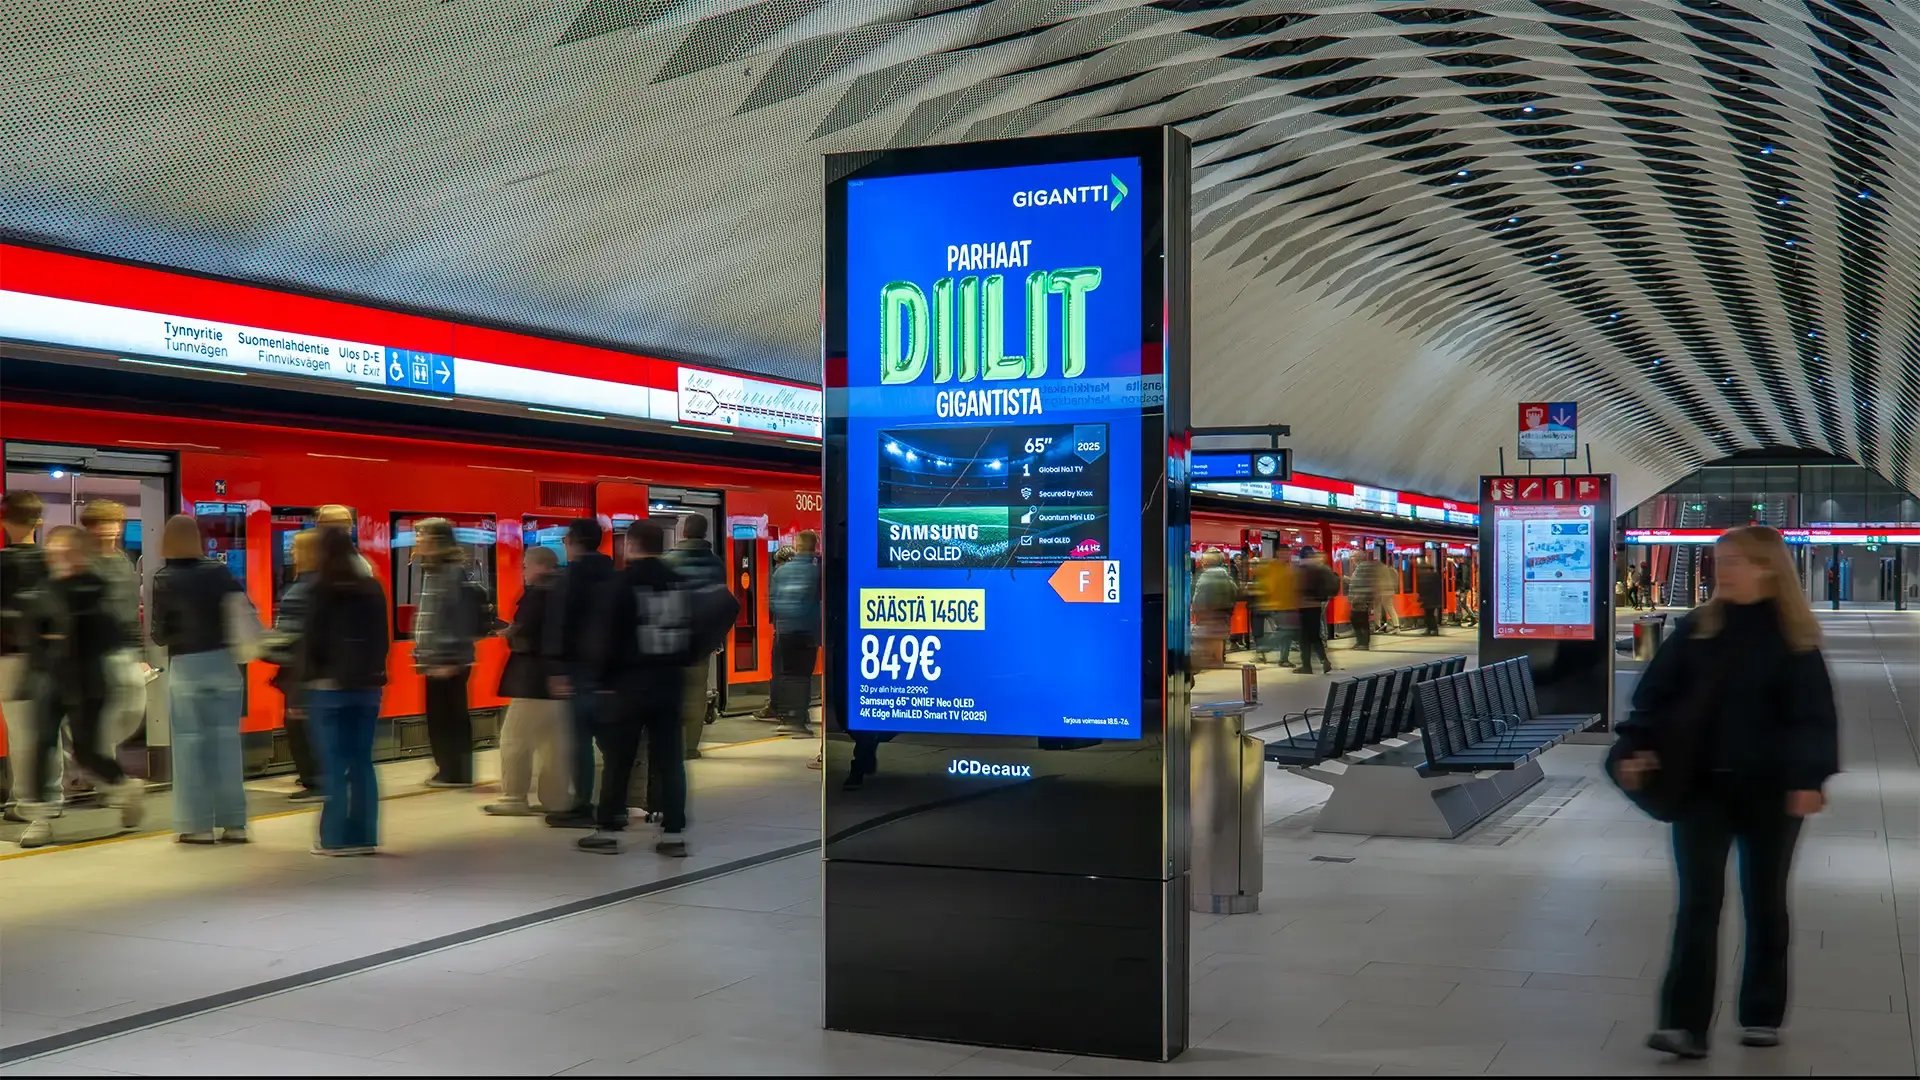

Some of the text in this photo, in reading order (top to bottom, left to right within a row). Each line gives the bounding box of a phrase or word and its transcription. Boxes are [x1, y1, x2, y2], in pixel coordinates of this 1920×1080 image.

[1012, 184, 1108, 208] GIGANTTI
[947, 239, 1032, 271] PARHAAT
[880, 266, 1102, 385] DIILIT
[164, 321, 380, 363] Tynnyritie Suomenlahdentie Ulos D-E
[165, 337, 380, 377] Tunnvägen Finnviksvägen Ut Exit
[936, 388, 1042, 417] GIGANTISTA
[1077, 442, 1101, 452] 2025
[1023, 463, 1031, 477] 1
[1074, 465, 1084, 473] TV
[795, 494, 823, 511] 306-D
[1038, 490, 1066, 498] Secured
[1067, 490, 1075, 498] by
[1083, 513, 1096, 521] LED
[889, 523, 979, 541] SAMSUNG
[889, 545, 962, 561] Neo QLED
[1107, 562, 1117, 575] A
[1079, 570, 1090, 593] F
[1107, 588, 1117, 601] G
[866, 595, 979, 624] SÄÄSTÄ 1450€
[861, 634, 942, 681] 849€
[860, 685, 929, 694] 30 pv alin hinta 2299€
[860, 695, 895, 708] Samsung
[936, 698, 952, 708] Neo
[953, 698, 975, 708] QLED
[860, 708, 987, 722] 4K Edge MiniLED Smart TV (2025)
[1062, 716, 1081, 725] Tarjous
[948, 758, 1032, 778] JCDecaux
